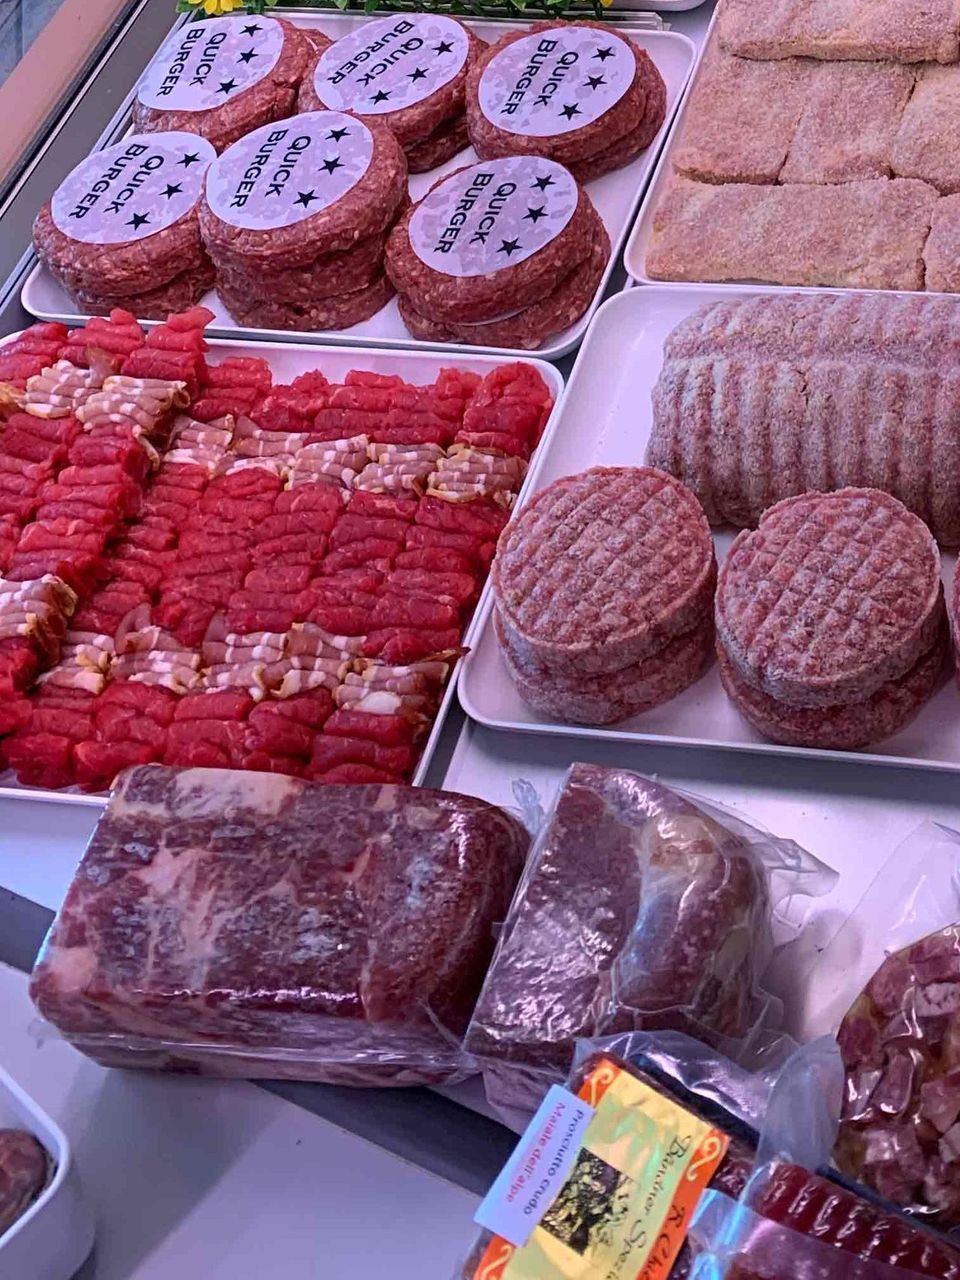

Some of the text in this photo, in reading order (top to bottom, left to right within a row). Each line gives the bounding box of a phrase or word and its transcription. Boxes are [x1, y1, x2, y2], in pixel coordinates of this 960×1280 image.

[156, 28, 206, 96] BURGER
[189, 32, 227, 85] QUICK
[327, 19, 415, 85] BURGER
[355, 37, 424, 87] QUICK
[500, 38, 558, 115] BURGER
[533, 51, 579, 106] QUICK
[68, 143, 148, 219] BURGER
[104, 155, 164, 214] QUICK
[230, 129, 288, 208] BURGER
[264, 135, 311, 197] QUICK
[433, 173, 494, 253] BURGER
[469, 182, 517, 245] QUICK
[523, 1176, 550, 1215] crudo
